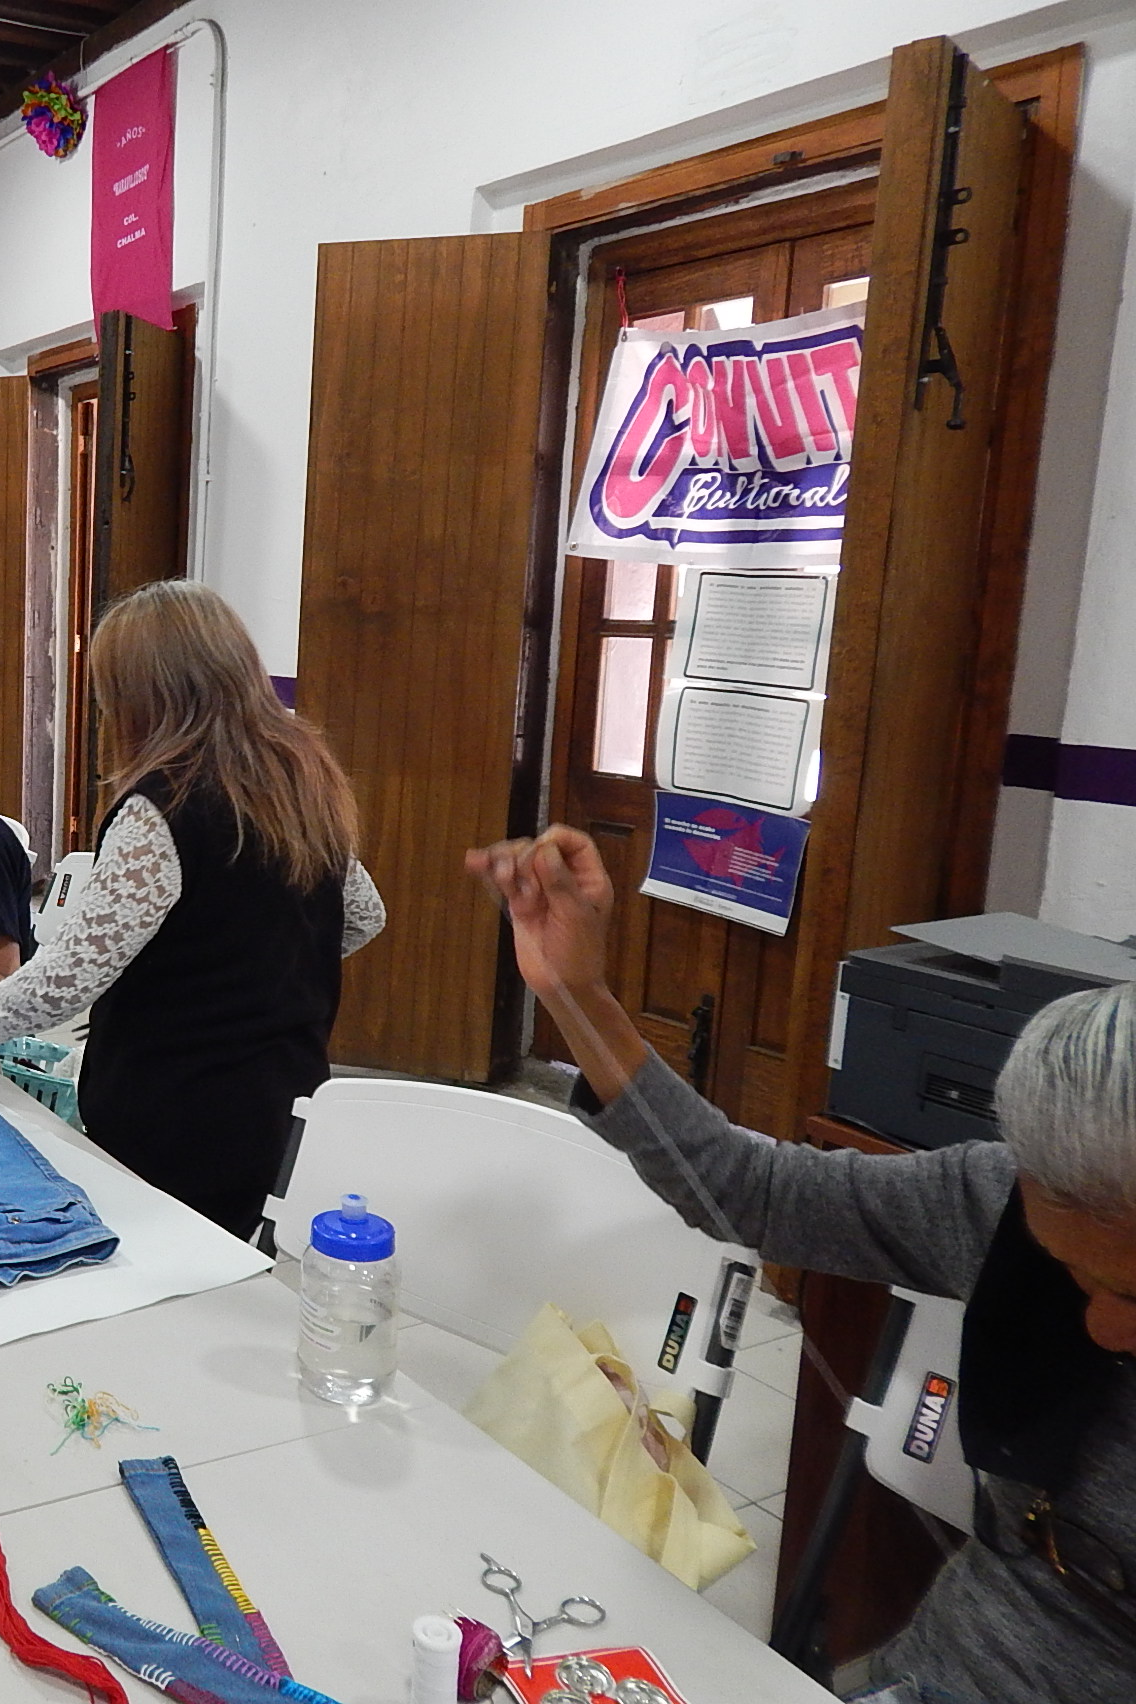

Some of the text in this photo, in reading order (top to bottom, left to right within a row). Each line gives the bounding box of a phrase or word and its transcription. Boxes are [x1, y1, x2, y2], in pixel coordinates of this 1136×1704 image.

[117, 227, 146, 249] CHALMA
[602, 339, 860, 519] CONVIT
[679, 463, 851, 524] Cultural
[661, 1314, 690, 1370] DUNA
[909, 1395, 946, 1458] DUNA
